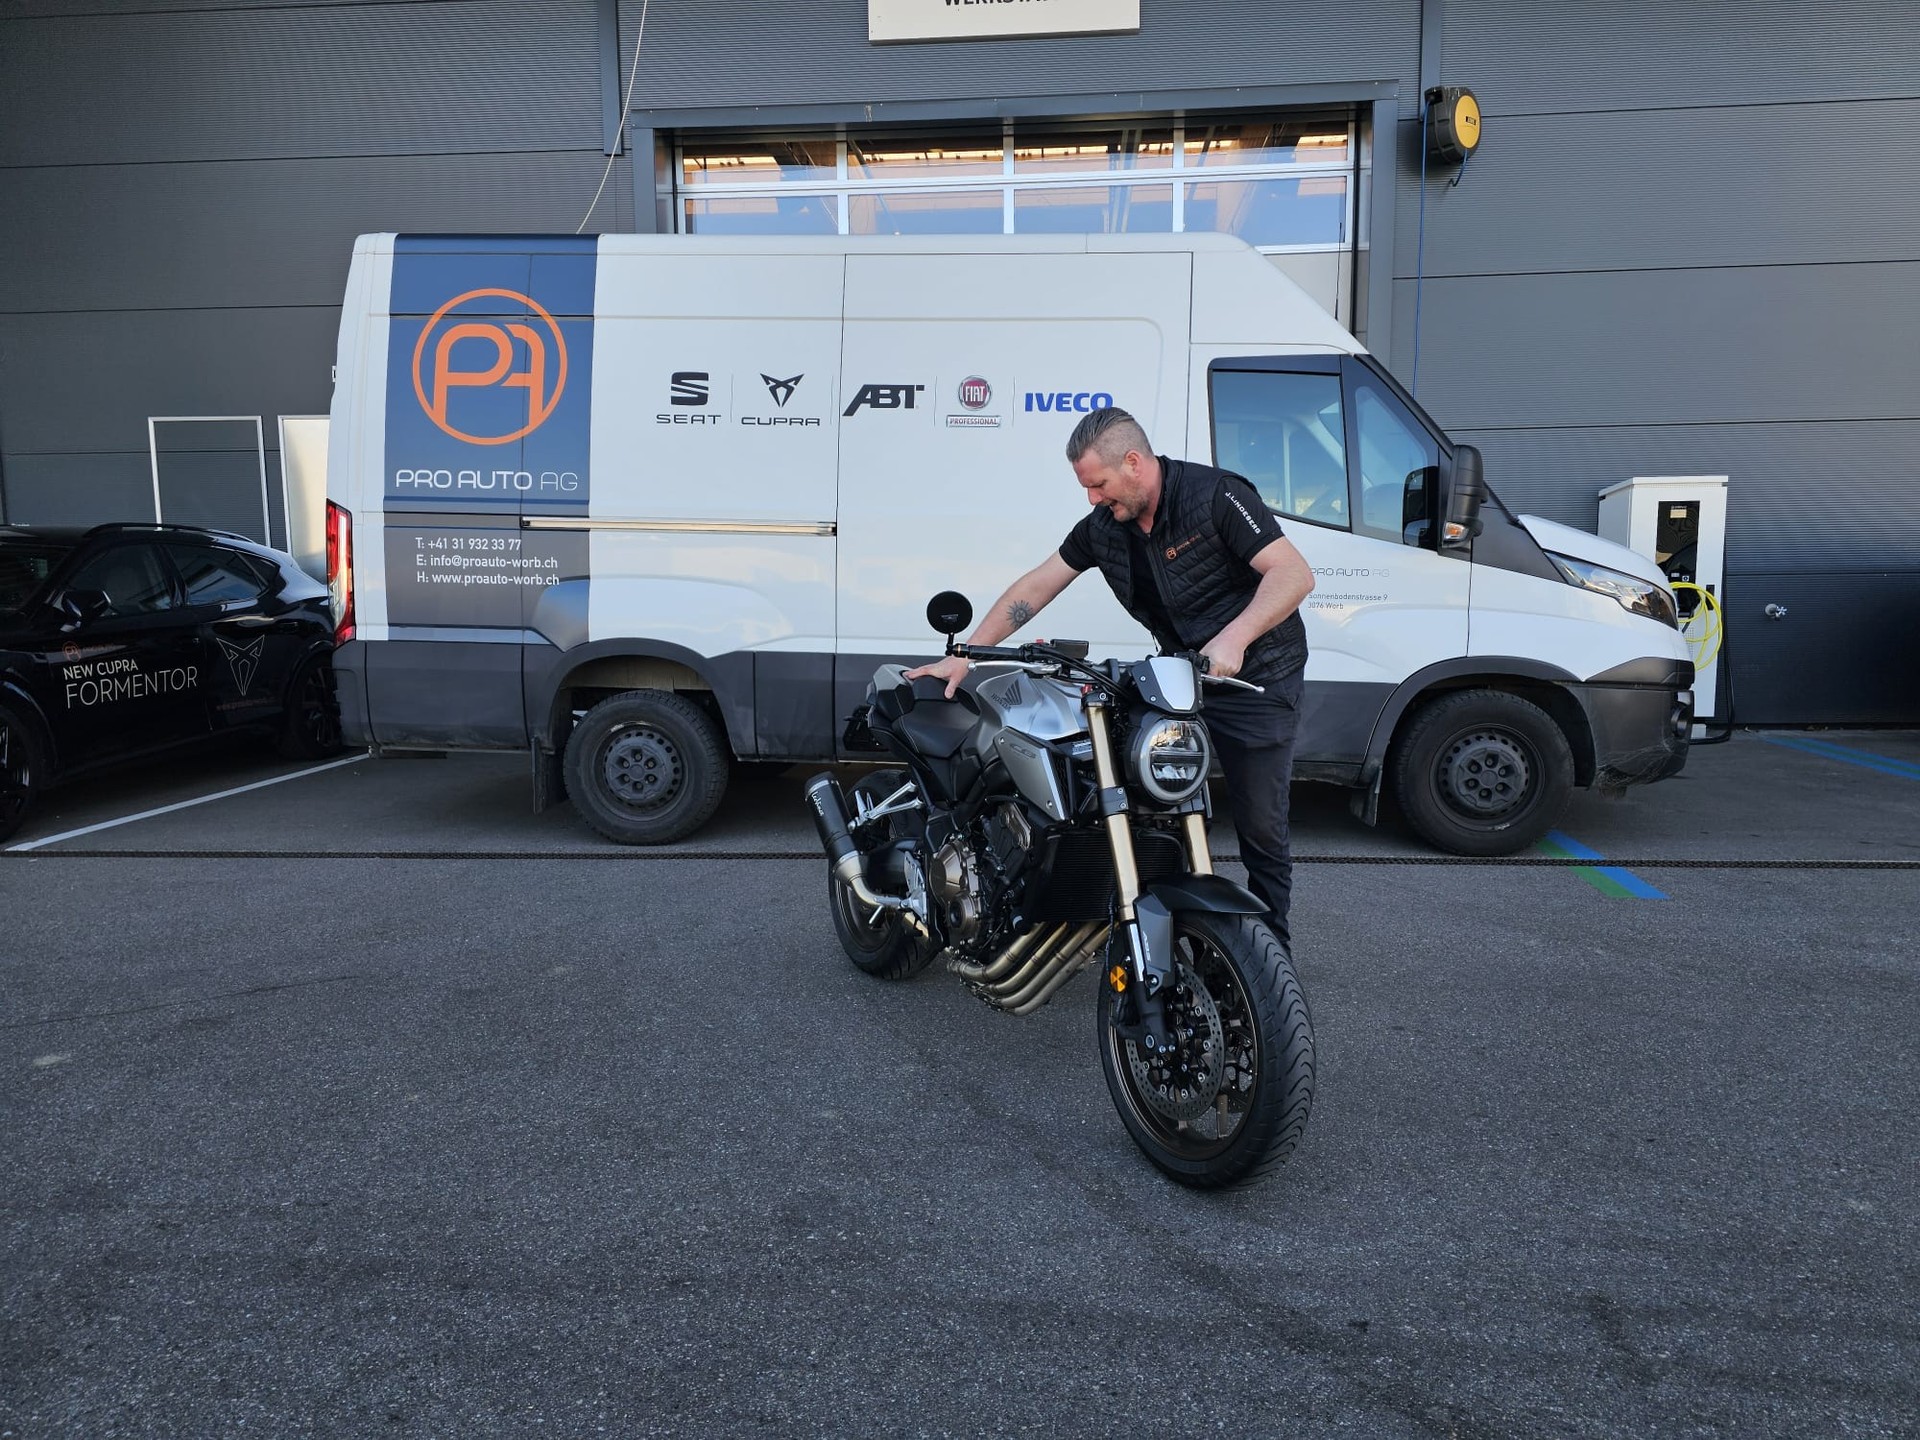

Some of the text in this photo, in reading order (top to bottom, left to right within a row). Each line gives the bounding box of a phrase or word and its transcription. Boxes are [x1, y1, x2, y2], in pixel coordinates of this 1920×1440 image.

[842, 384, 925, 416] ABT
[965, 385, 986, 402] FIAT
[1025, 392, 1114, 412] IVECO
[656, 414, 722, 425] SEAT
[741, 416, 820, 426] CUPRA
[950, 418, 998, 426] PROFESSIONAL
[395, 469, 578, 491] PRO AUTO AG
[415, 537, 522, 550] T: +41 31 932 33 77
[416, 554, 558, 569] E: info@proauto-worb.ch
[417, 571, 560, 586] H: www.proauto-worb.ch
[1309, 567, 1334, 576] PRO
[1335, 567, 1370, 577] AUTO
[1383, 593, 1388, 601] 9
[1326, 602, 1344, 610] Worb
[63, 658, 139, 680] NEW CUPRA
[66, 666, 198, 709] FORMENTOR
